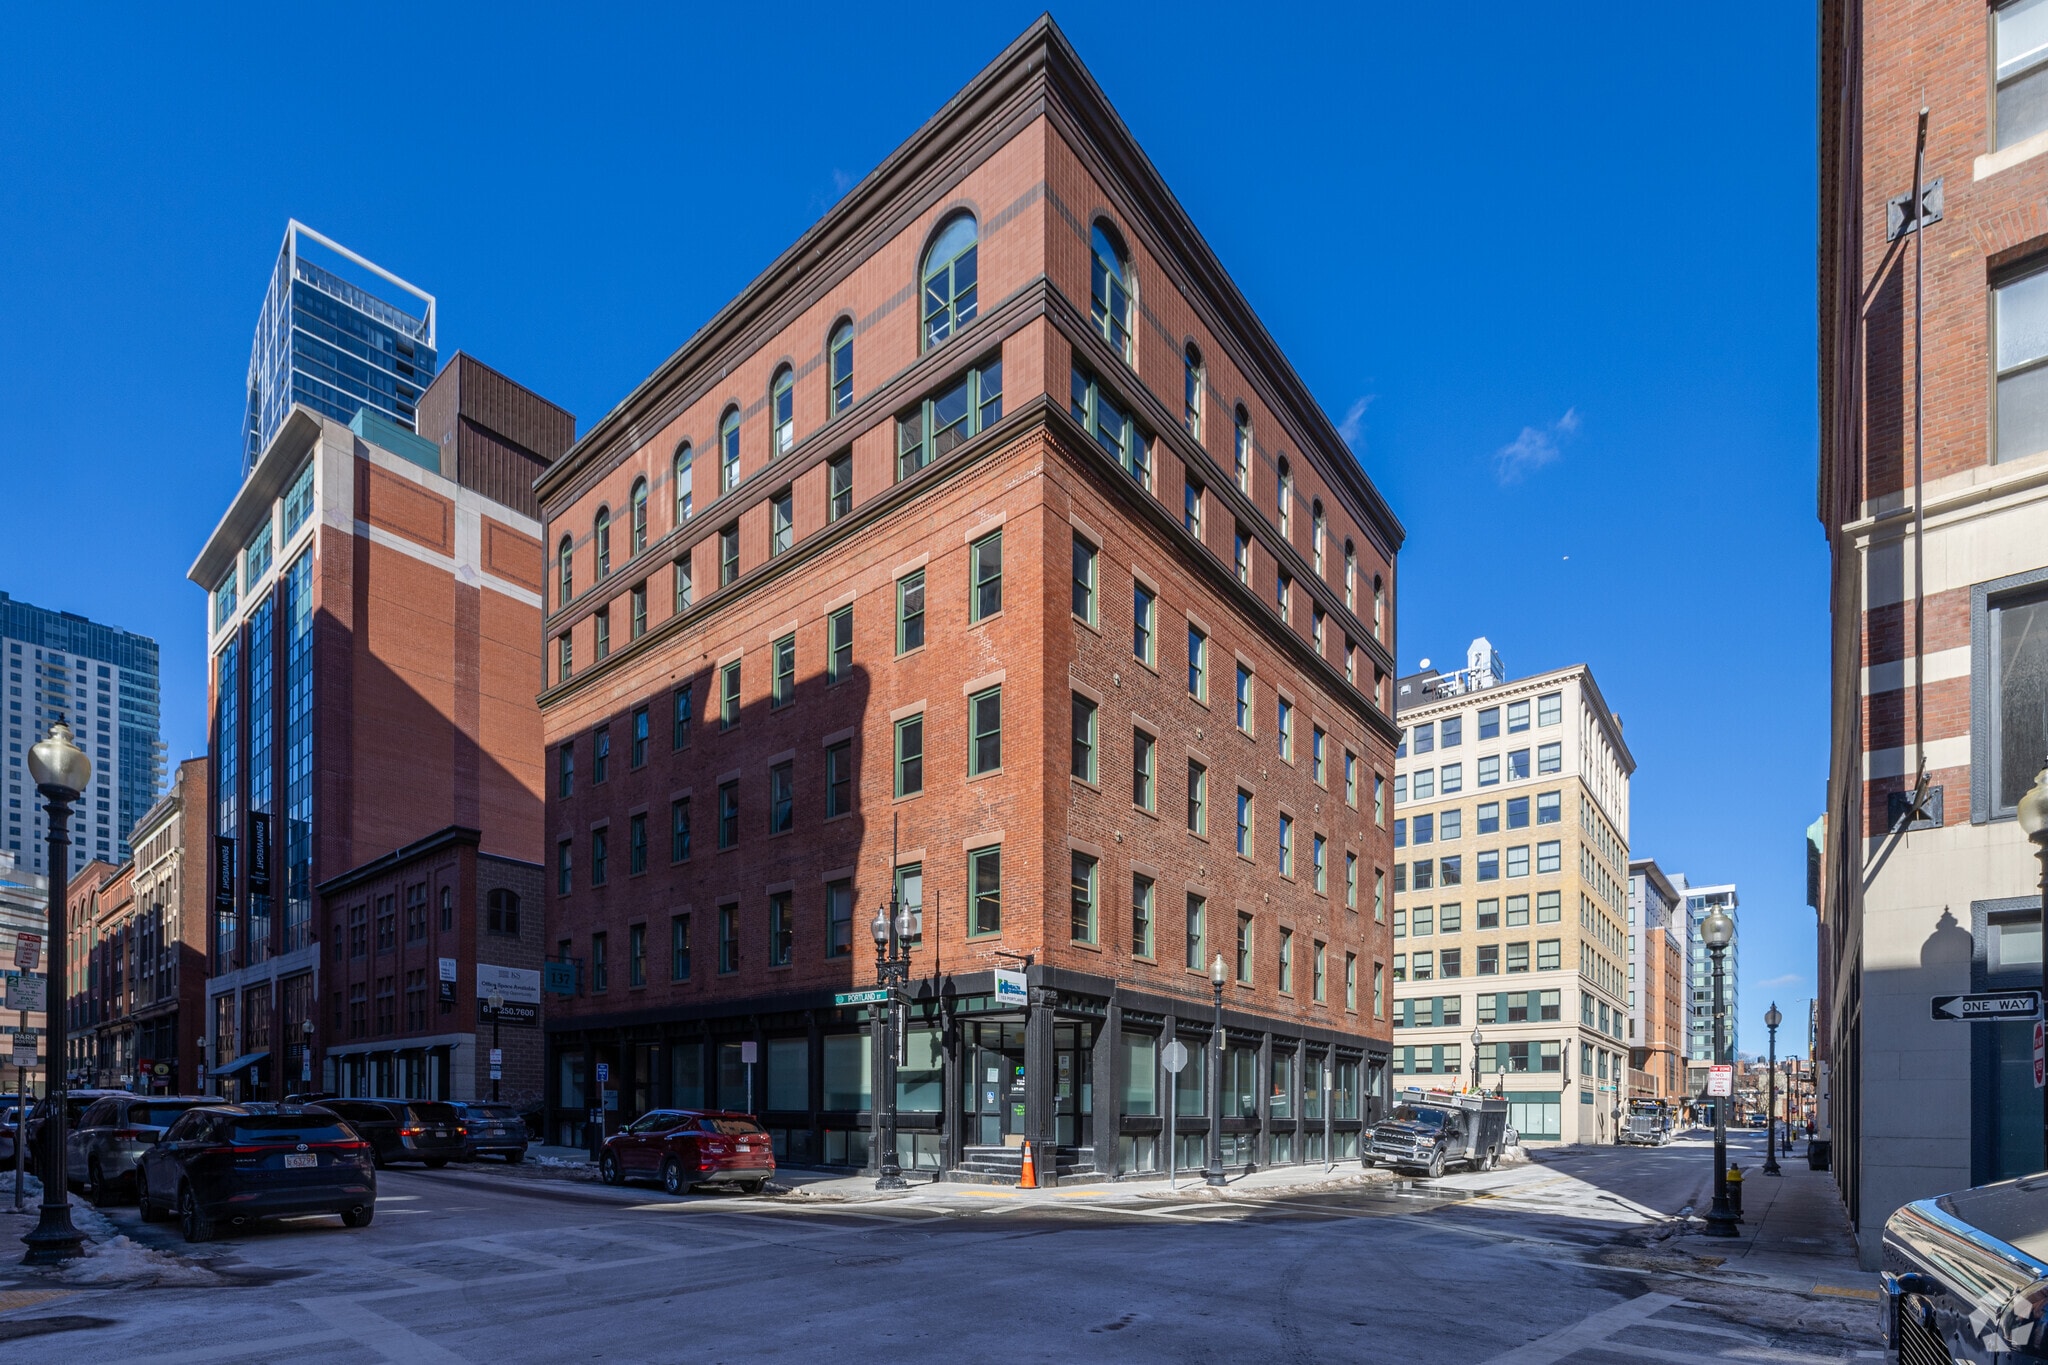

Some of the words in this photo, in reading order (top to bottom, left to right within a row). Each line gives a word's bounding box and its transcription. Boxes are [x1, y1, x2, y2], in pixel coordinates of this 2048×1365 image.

[256, 820, 265, 870] PENNYWEIGHT
[222, 845, 230, 890] PENNYWEIGHT
[551, 972, 570, 985] 137
[847, 993, 876, 1003] PORTLAND
[483, 1005, 534, 1017] 61.250.7600
[1962, 1001, 1990, 1011] ONE
[1999, 999, 2029, 1010] WAY
[14, 1033, 36, 1041] PARK
